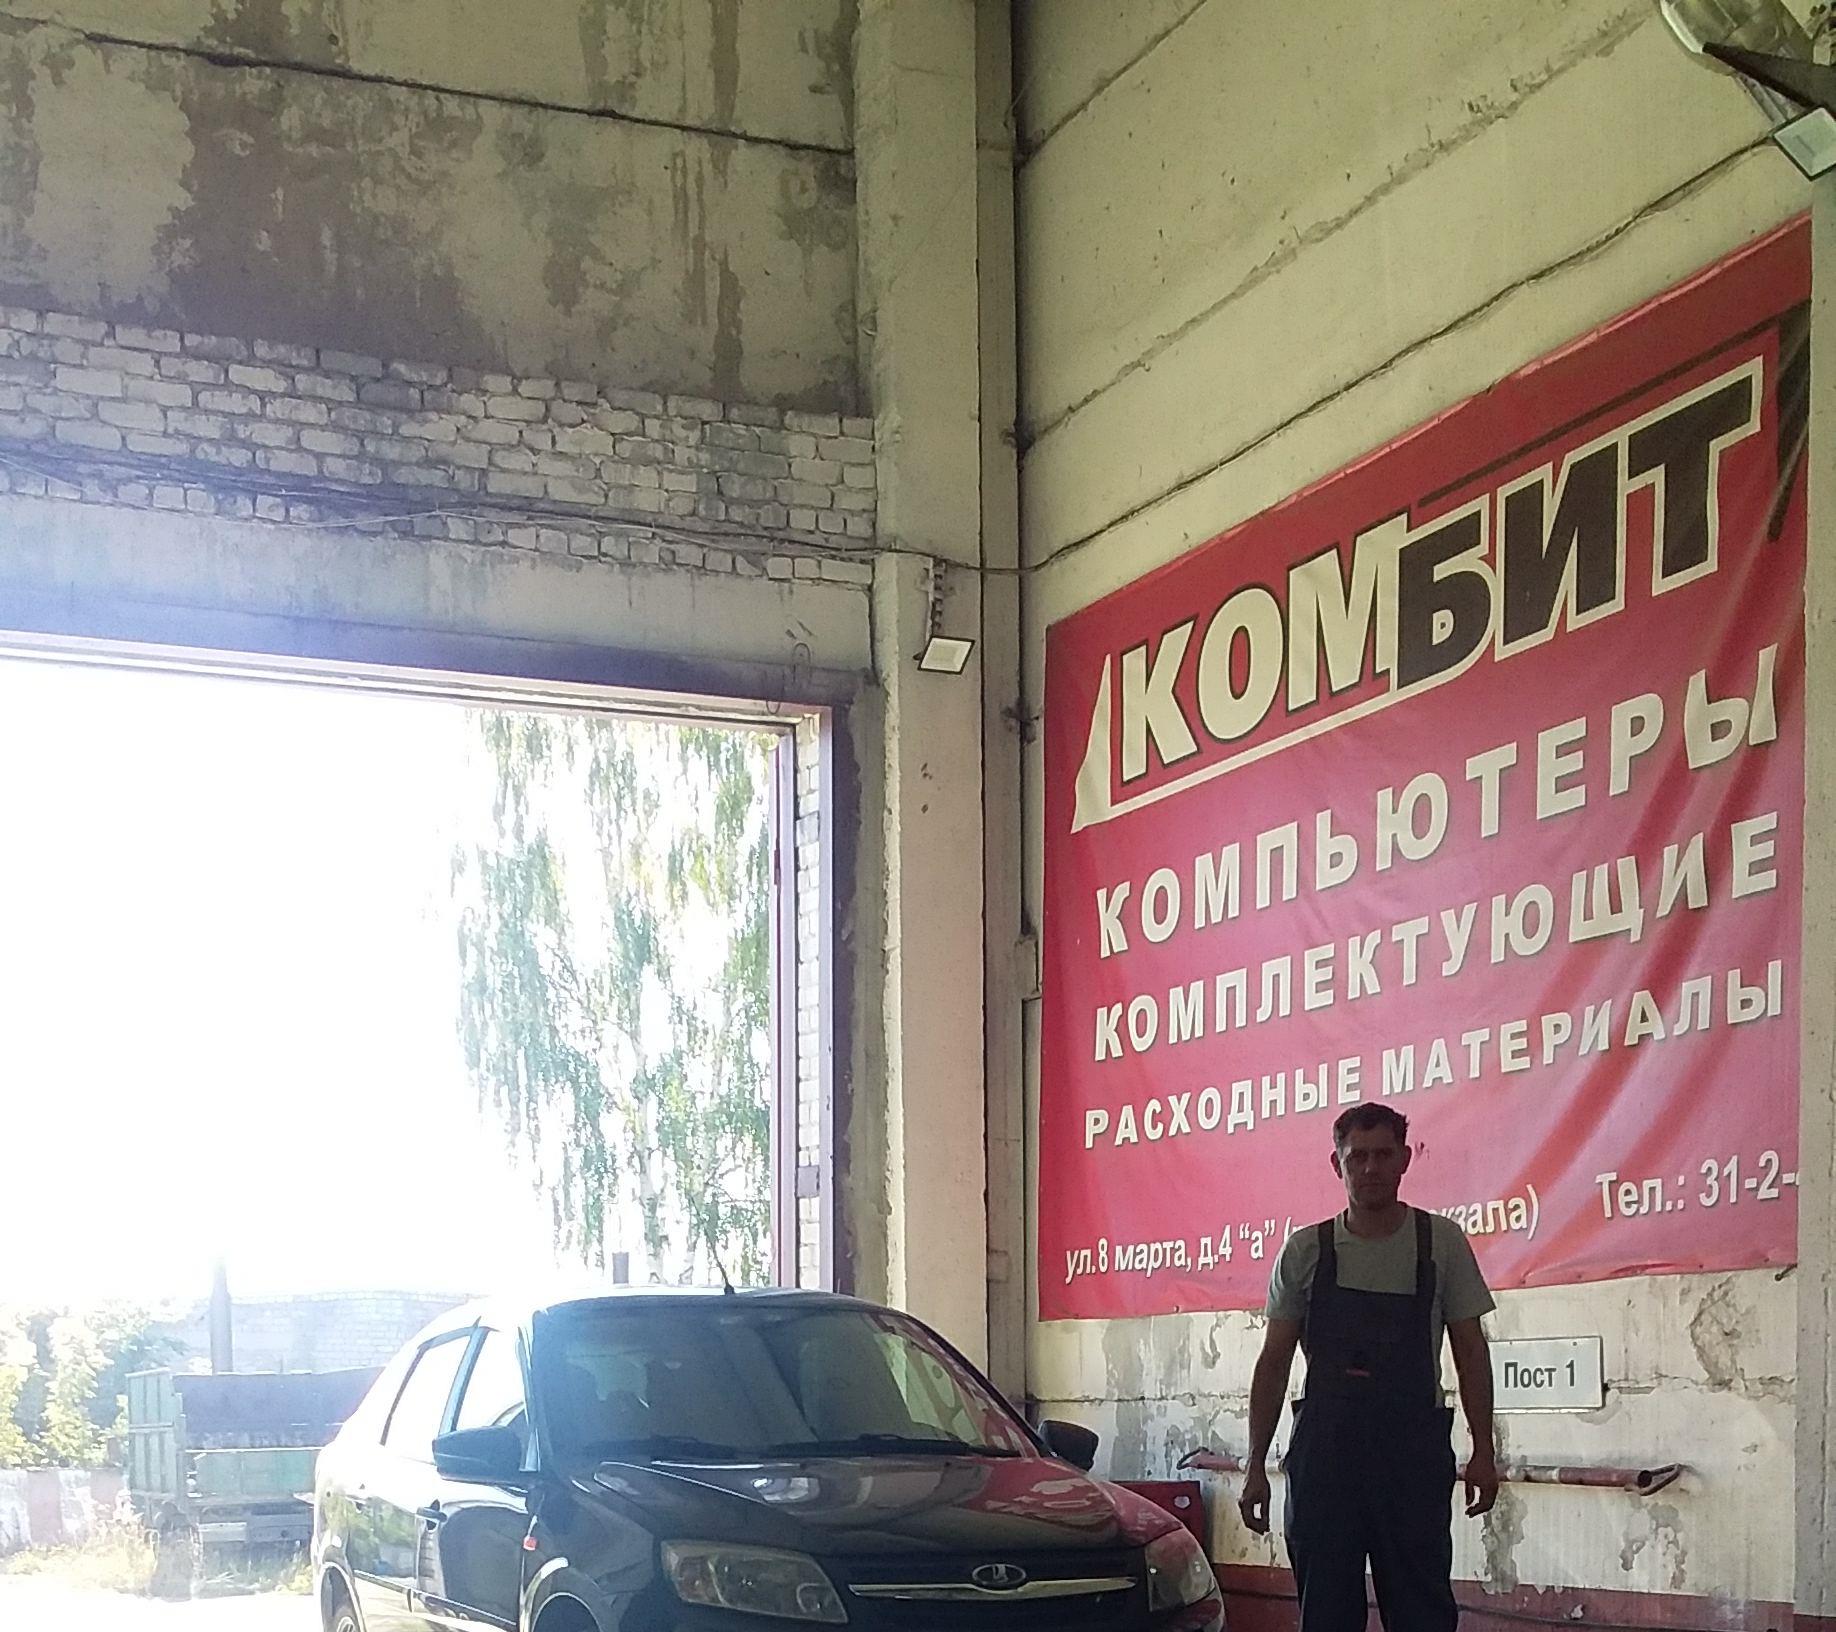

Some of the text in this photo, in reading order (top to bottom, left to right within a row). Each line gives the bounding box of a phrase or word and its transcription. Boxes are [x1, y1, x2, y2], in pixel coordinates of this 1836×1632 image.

[1120, 356, 1764, 784] КОМБИТ
[1095, 643, 1778, 959] КОМПЬЮТЕРЫ
[1093, 811, 1779, 1061] КОМПЛЕКТУЮЩИЕ
[1083, 960, 1784, 1150] РАСХОДНЫЕ МАТЕРИАЛЫ
[1114, 1238, 1192, 1277] марта,
[1595, 1150, 1799, 1219] Тел.: 31-2-
[1504, 1359, 1575, 1389] Пост 1
